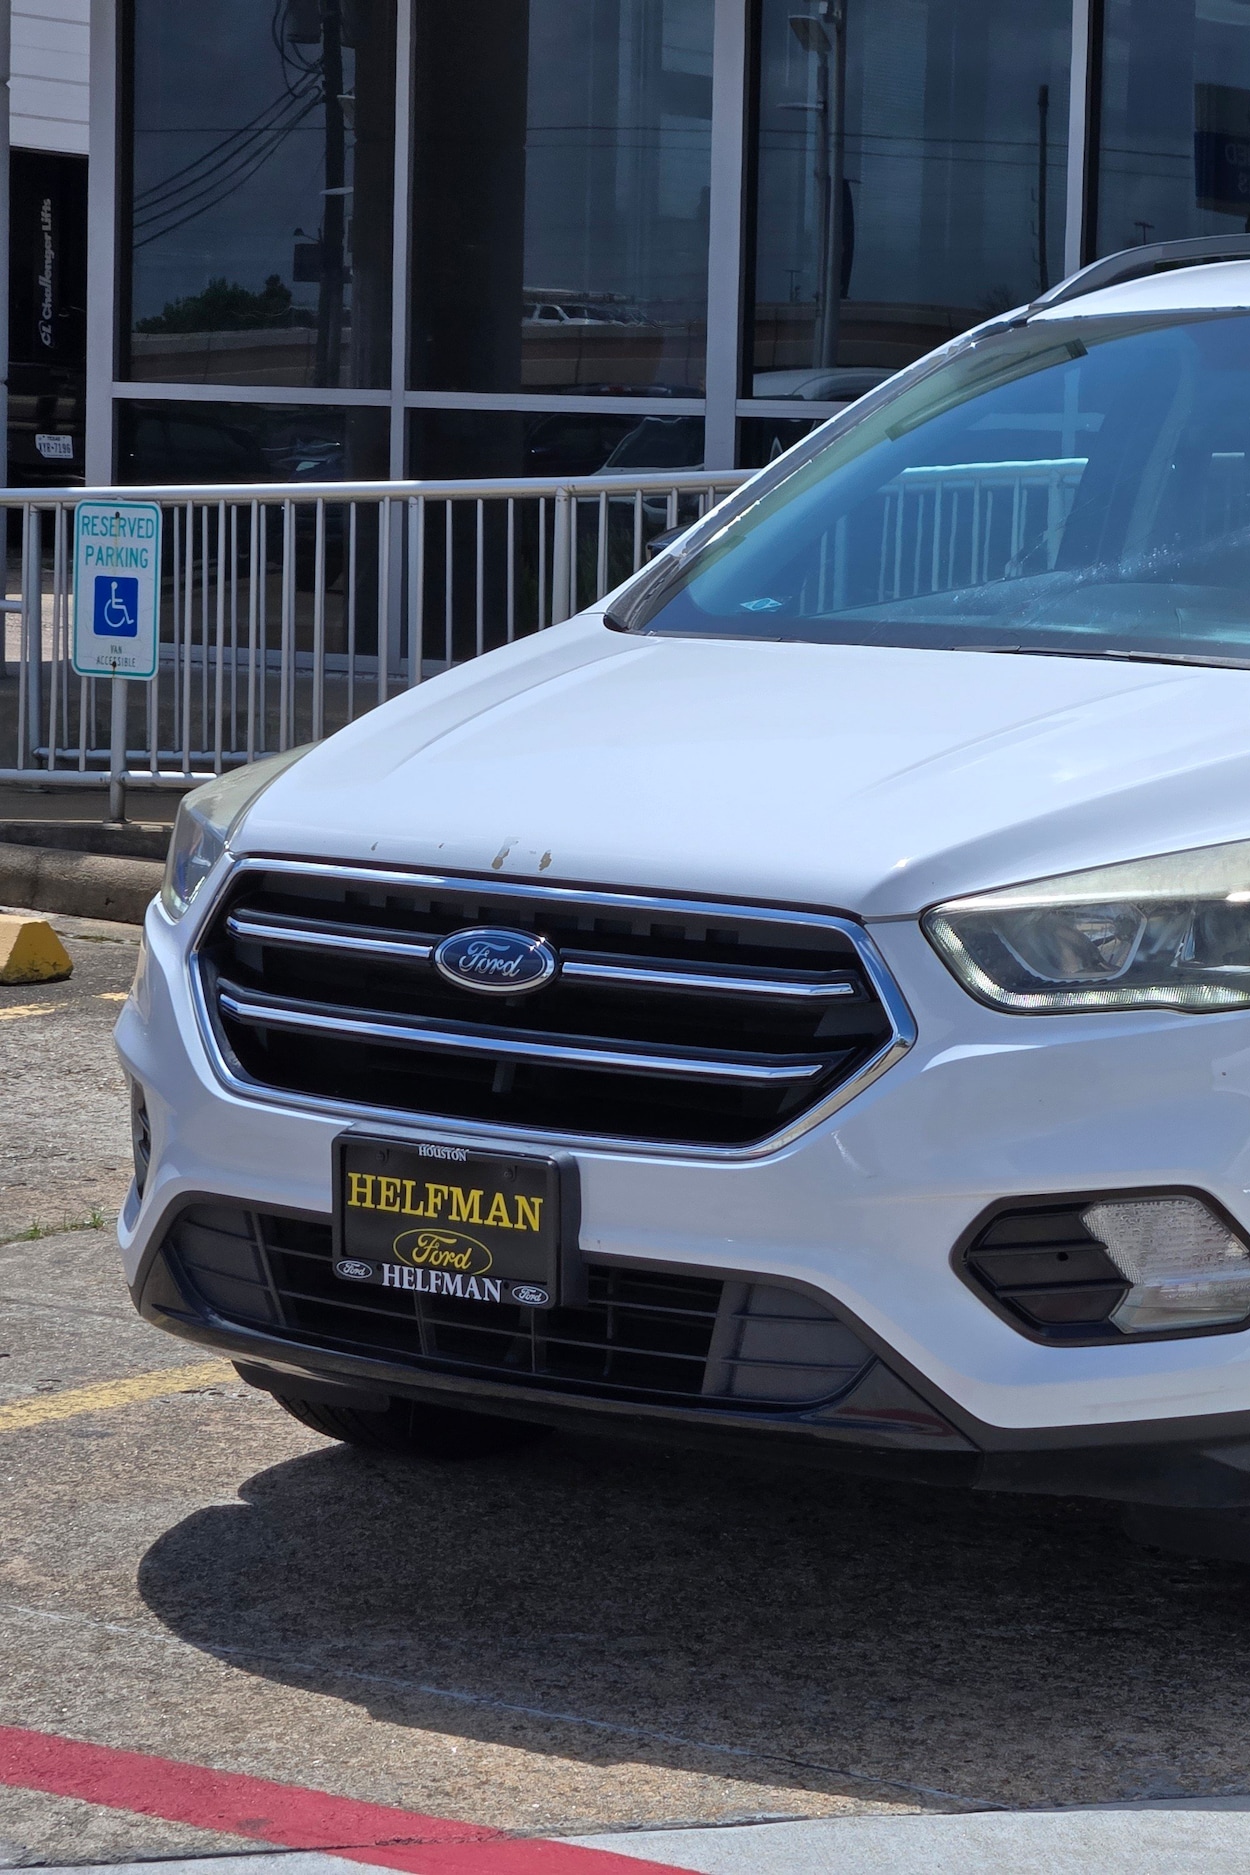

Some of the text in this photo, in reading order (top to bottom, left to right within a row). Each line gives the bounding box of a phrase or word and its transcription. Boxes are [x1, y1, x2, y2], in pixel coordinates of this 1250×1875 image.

[41, 198, 52, 231] Lifts
[38, 232, 55, 320] Challenger
[81, 515, 155, 539] RESERVED
[85, 545, 149, 569] PARKING
[458, 940, 524, 978] Ford
[418, 1143, 470, 1162] HOUSTON
[347, 1172, 544, 1232] HELFMAN
[411, 1232, 473, 1271] Ford
[342, 1261, 367, 1277] Ford
[381, 1262, 503, 1304] HELFMAN
[518, 1286, 543, 1302] Ford
